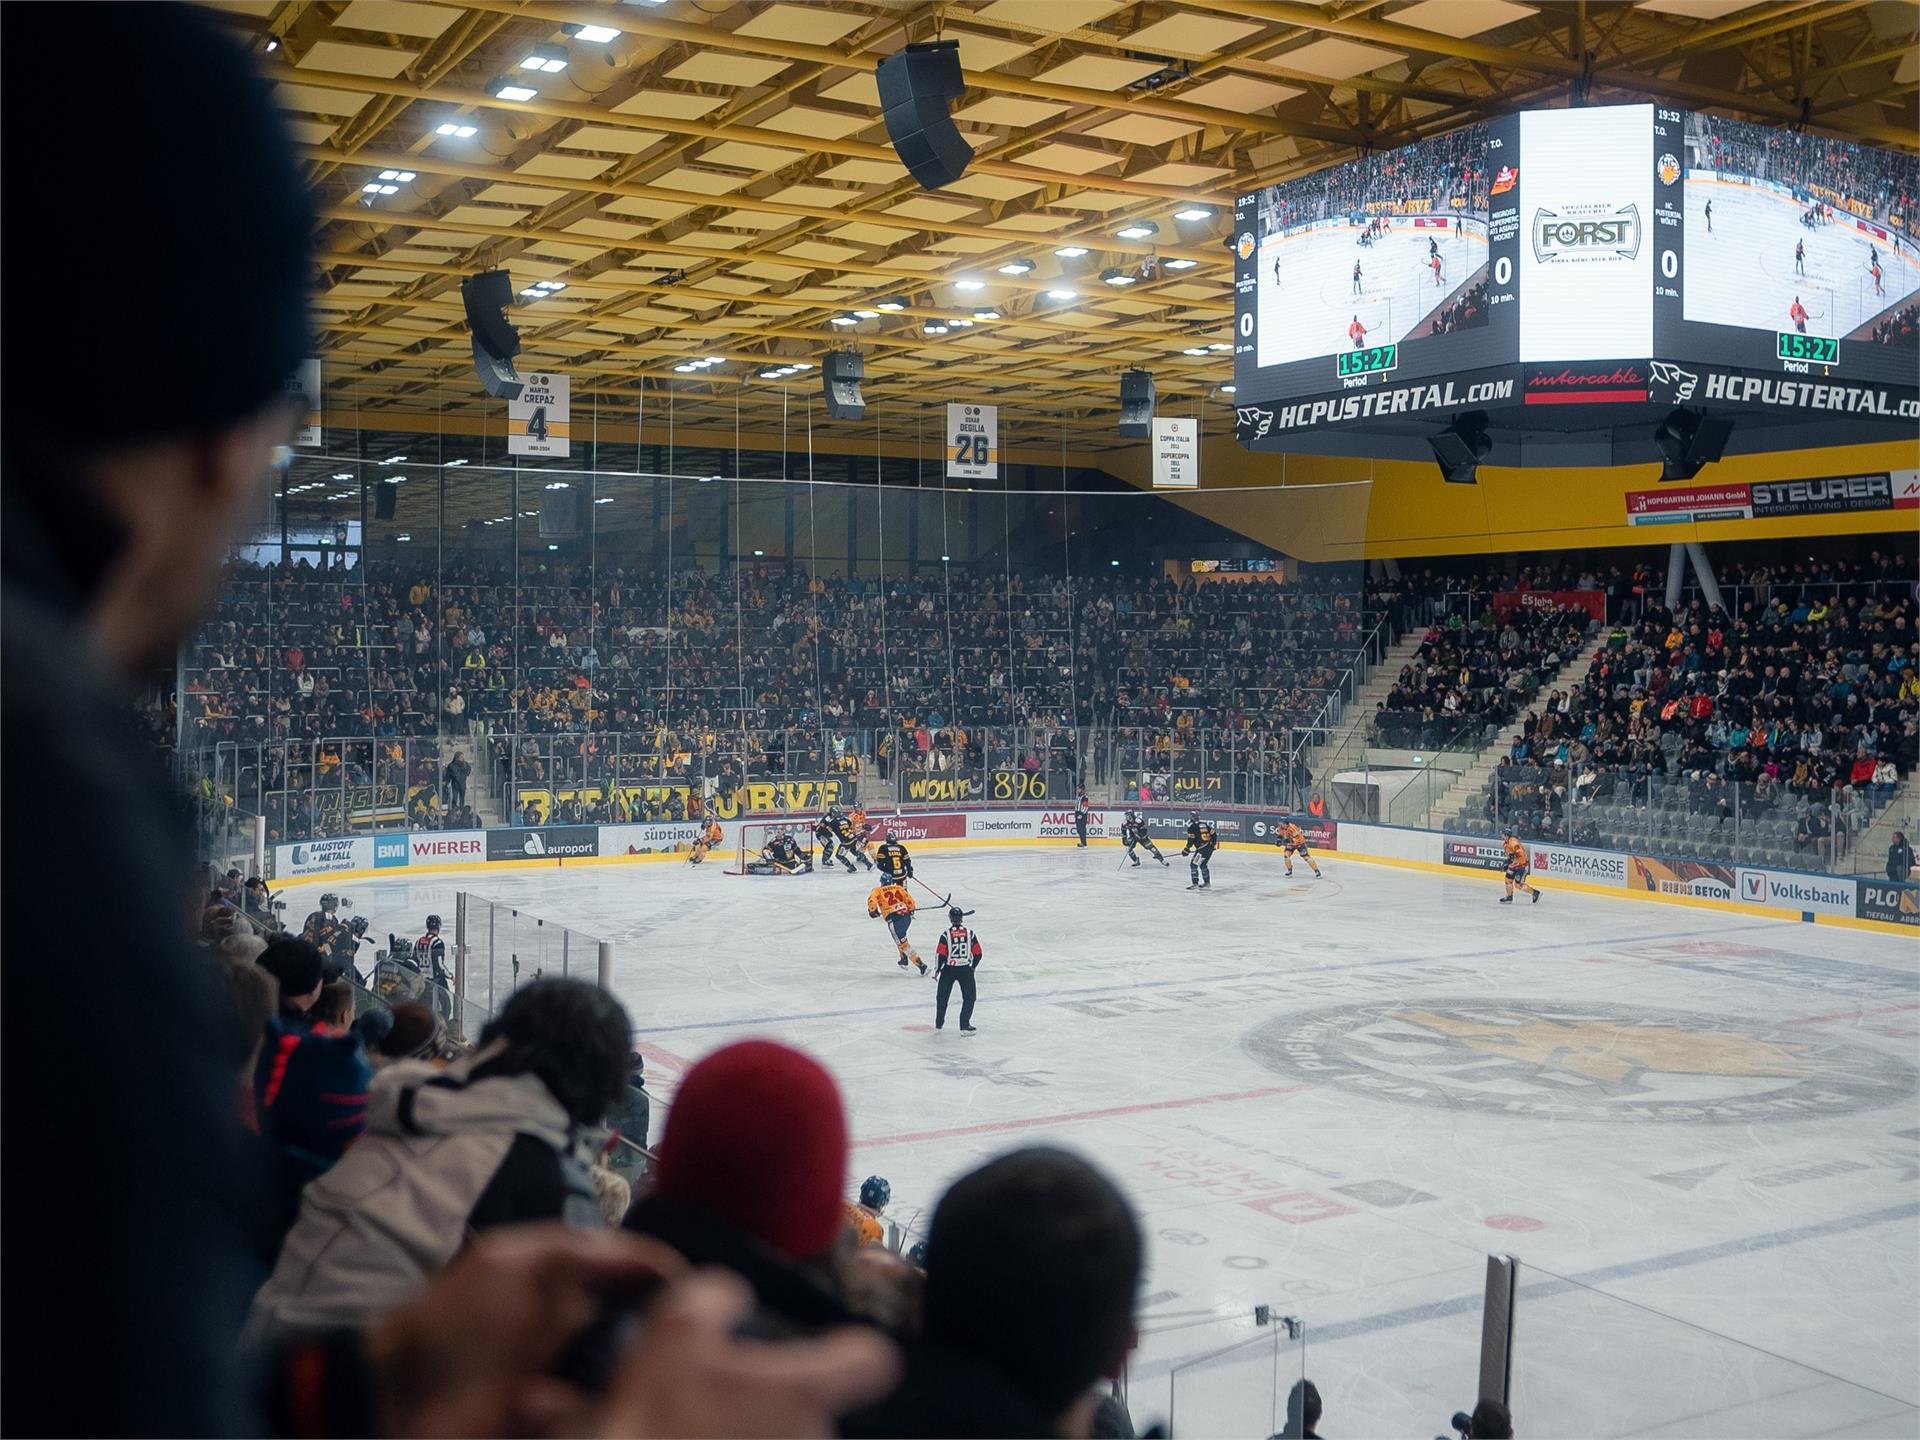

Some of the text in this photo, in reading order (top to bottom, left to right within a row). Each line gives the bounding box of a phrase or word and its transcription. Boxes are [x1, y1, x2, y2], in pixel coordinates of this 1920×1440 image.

[1658, 109, 1681, 123] 19:52
[1493, 232, 1515, 242] HOCKEY
[1543, 220, 1632, 247] FORST
[1495, 256, 1512, 285] 0
[1661, 249, 1678, 279] 0
[1655, 286, 1664, 295] 10
[1491, 293, 1515, 305] 10 min.
[1240, 312, 1254, 337] 0
[1780, 333, 1838, 361] 15:27
[1340, 346, 1394, 374] 15:27
[1783, 360, 1829, 376] Period 1
[1343, 371, 1388, 389] Period 1
[1528, 367, 1644, 386] intercable
[529, 386, 550, 394] MARTIN
[1705, 373, 1920, 418] HCPUSTERTAL.CO
[524, 393, 555, 405] CREPAZ
[1279, 379, 1514, 429] HCPUSTERTAL.COM
[526, 405, 549, 442] 4
[959, 423, 985, 433] DEGILIA
[1159, 434, 1190, 443] COPPA ITALIA
[955, 433, 990, 467] 26
[1160, 452, 1190, 460] SUPERCOPPA
[1647, 490, 1747, 505] HOPFGARTNER JOHANN GmbH
[1752, 475, 1889, 505] STEURER
[1753, 503, 1799, 514] INTERIOR
[1808, 501, 1841, 511] LIVING
[1851, 498, 1890, 508] DESIGN
[909, 778, 972, 800] WOLVE
[1206, 777, 1221, 790] 71
[892, 819, 908, 827] lebe
[985, 821, 1032, 832] betonform
[1148, 818, 1216, 829] PLAICKR
[1040, 827, 1104, 836] PROFI CLOR
[310, 840, 354, 853] BAUSTOFF
[377, 843, 405, 859] BMI
[412, 840, 482, 857] WIERER
[547, 843, 593, 856] auroport
[1453, 845, 1475, 854] PRO
[318, 850, 352, 862] METALL
[892, 856, 901, 869] 5
[1550, 852, 1625, 874] SPARKASSE
[291, 862, 356, 876] www.baustoff-metall.it
[1550, 865, 1573, 874] CASSA
[1584, 869, 1624, 881] RISPARMIO
[1694, 884, 1731, 900] BETON
[1770, 881, 1850, 906] Volksbank
[1866, 911, 1895, 921] TIEFBAU
[951, 942, 969, 958] 28
